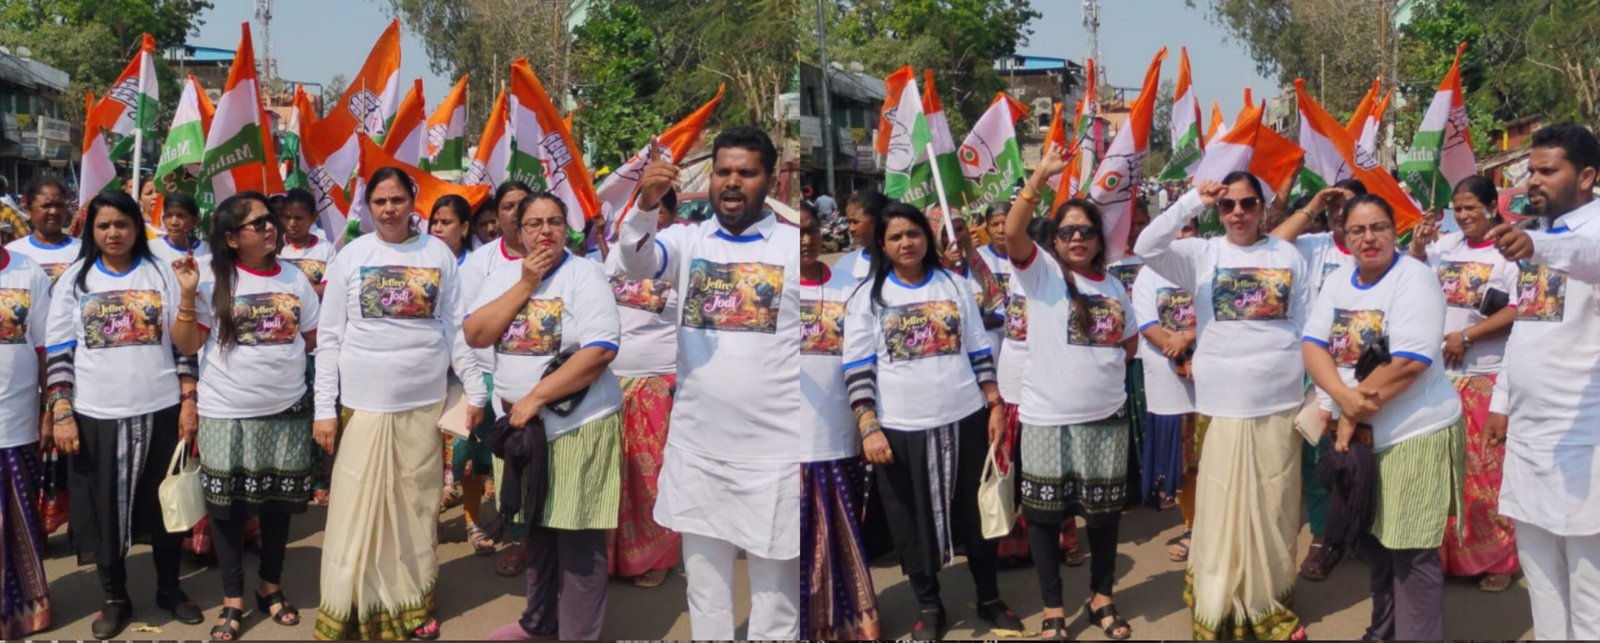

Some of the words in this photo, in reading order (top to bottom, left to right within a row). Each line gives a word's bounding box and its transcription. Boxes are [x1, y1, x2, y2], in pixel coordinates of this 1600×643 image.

[377, 276, 407, 289] Jeffrey
[1230, 279, 1259, 291] Jeffrey
[381, 289, 409, 306] Jodi
[703, 295, 738, 313] Jodi
[1234, 290, 1262, 307] Jodi
[98, 303, 127, 318] Jeffrey
[249, 305, 277, 319] Jeffrey
[104, 314, 131, 334] Jodi
[255, 317, 282, 334] Jodi
[899, 315, 928, 331] Jeffrey
[906, 327, 935, 346] Jodi
